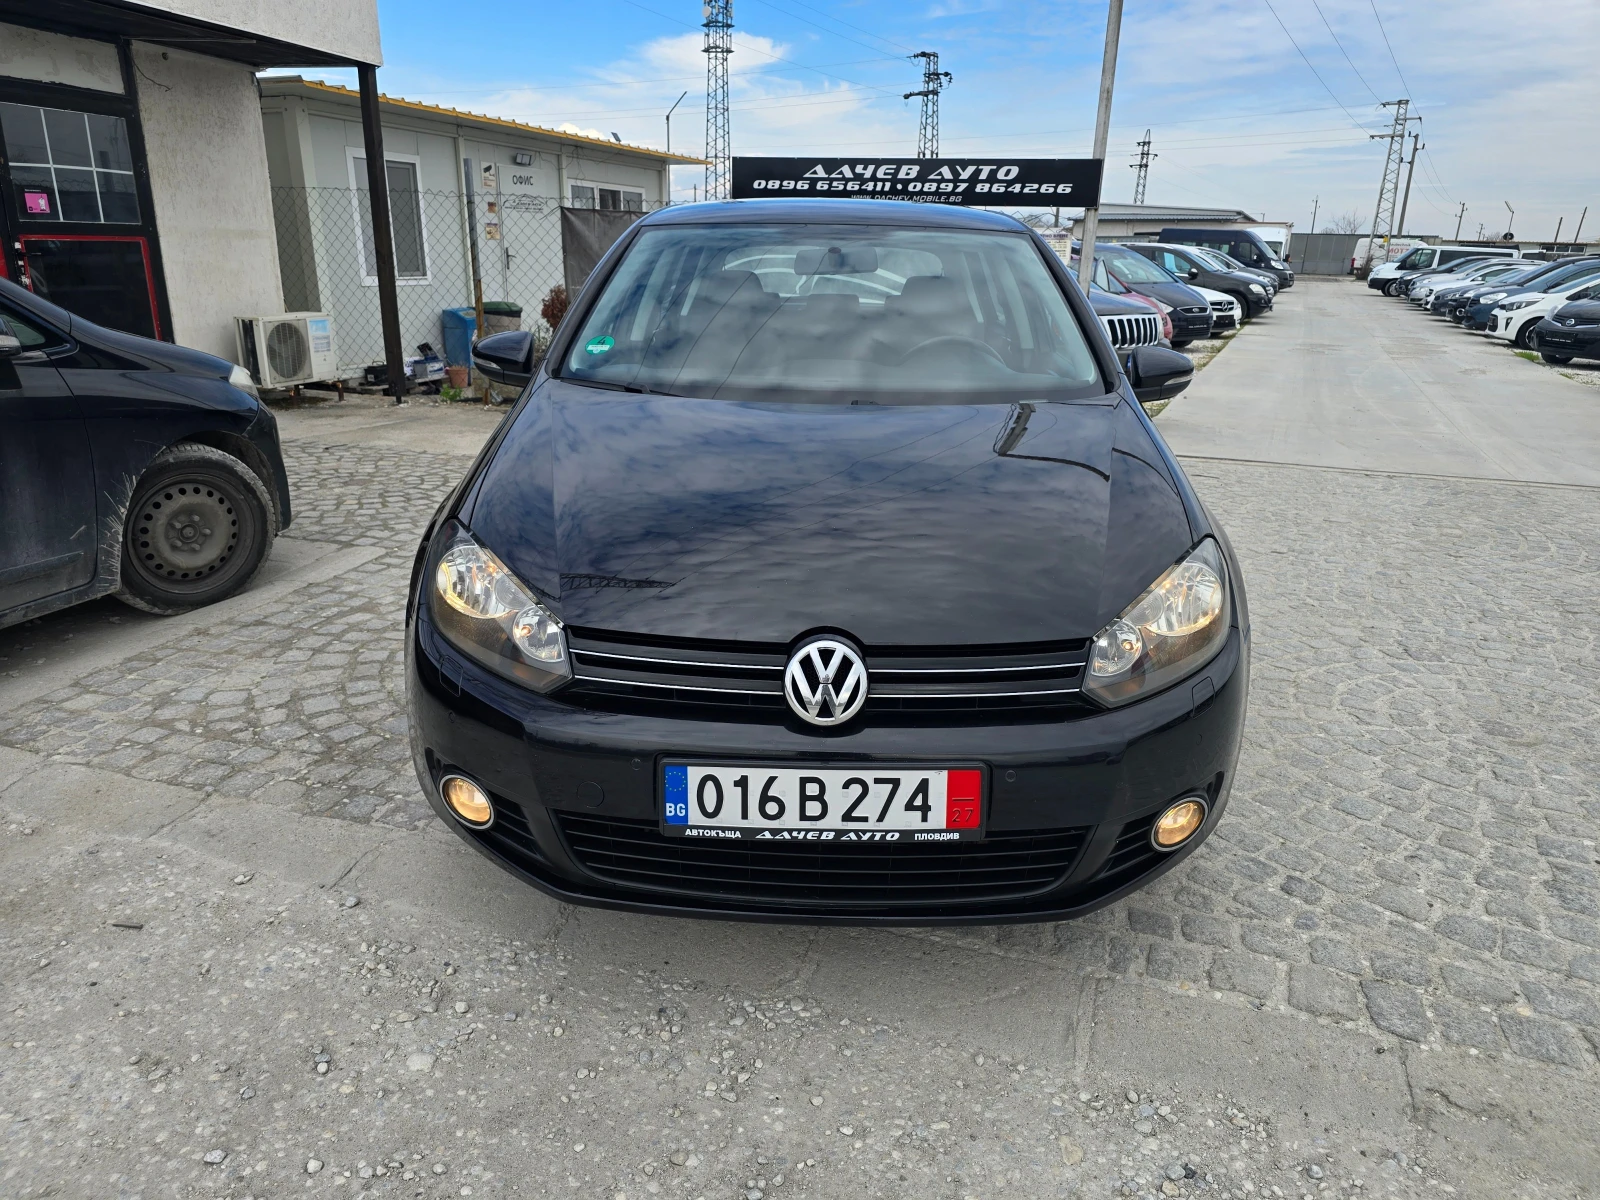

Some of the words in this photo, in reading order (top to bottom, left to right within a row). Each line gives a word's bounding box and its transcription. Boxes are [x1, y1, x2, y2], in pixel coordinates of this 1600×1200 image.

[802, 164, 921, 179] ДАЧЕВ
[927, 165, 1020, 180] АУТО
[512, 175, 533, 186] ОФИС
[752, 180, 811, 190] 0896
[815, 180, 892, 192] 656411
[907, 181, 972, 193] 0897
[974, 183, 1074, 194] 864266
[597, 336, 607, 346] 4
[665, 802, 686, 817] BG
[951, 807, 975, 823] 27
[684, 828, 742, 839] АВТОКЪЩА
[914, 832, 960, 841] ПЛОВДИВ
